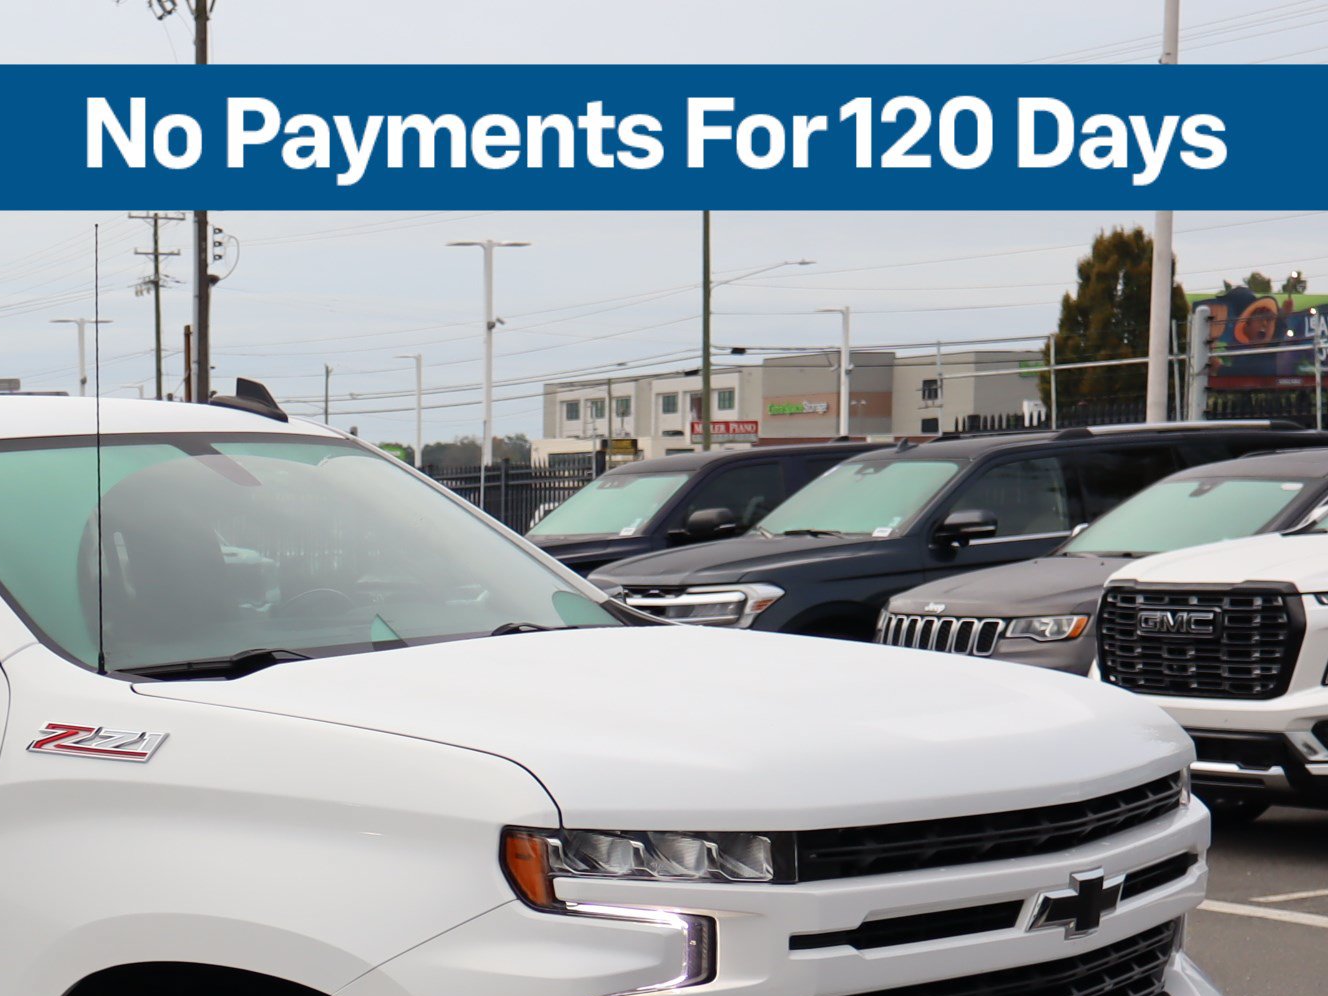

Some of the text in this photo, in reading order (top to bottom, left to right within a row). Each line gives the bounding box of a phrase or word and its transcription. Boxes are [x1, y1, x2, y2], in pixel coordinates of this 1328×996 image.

[693, 423, 726, 434] MLER
[924, 602, 946, 613] Jeep
[1137, 611, 1214, 633] GMC
[26, 721, 170, 763] Z71
